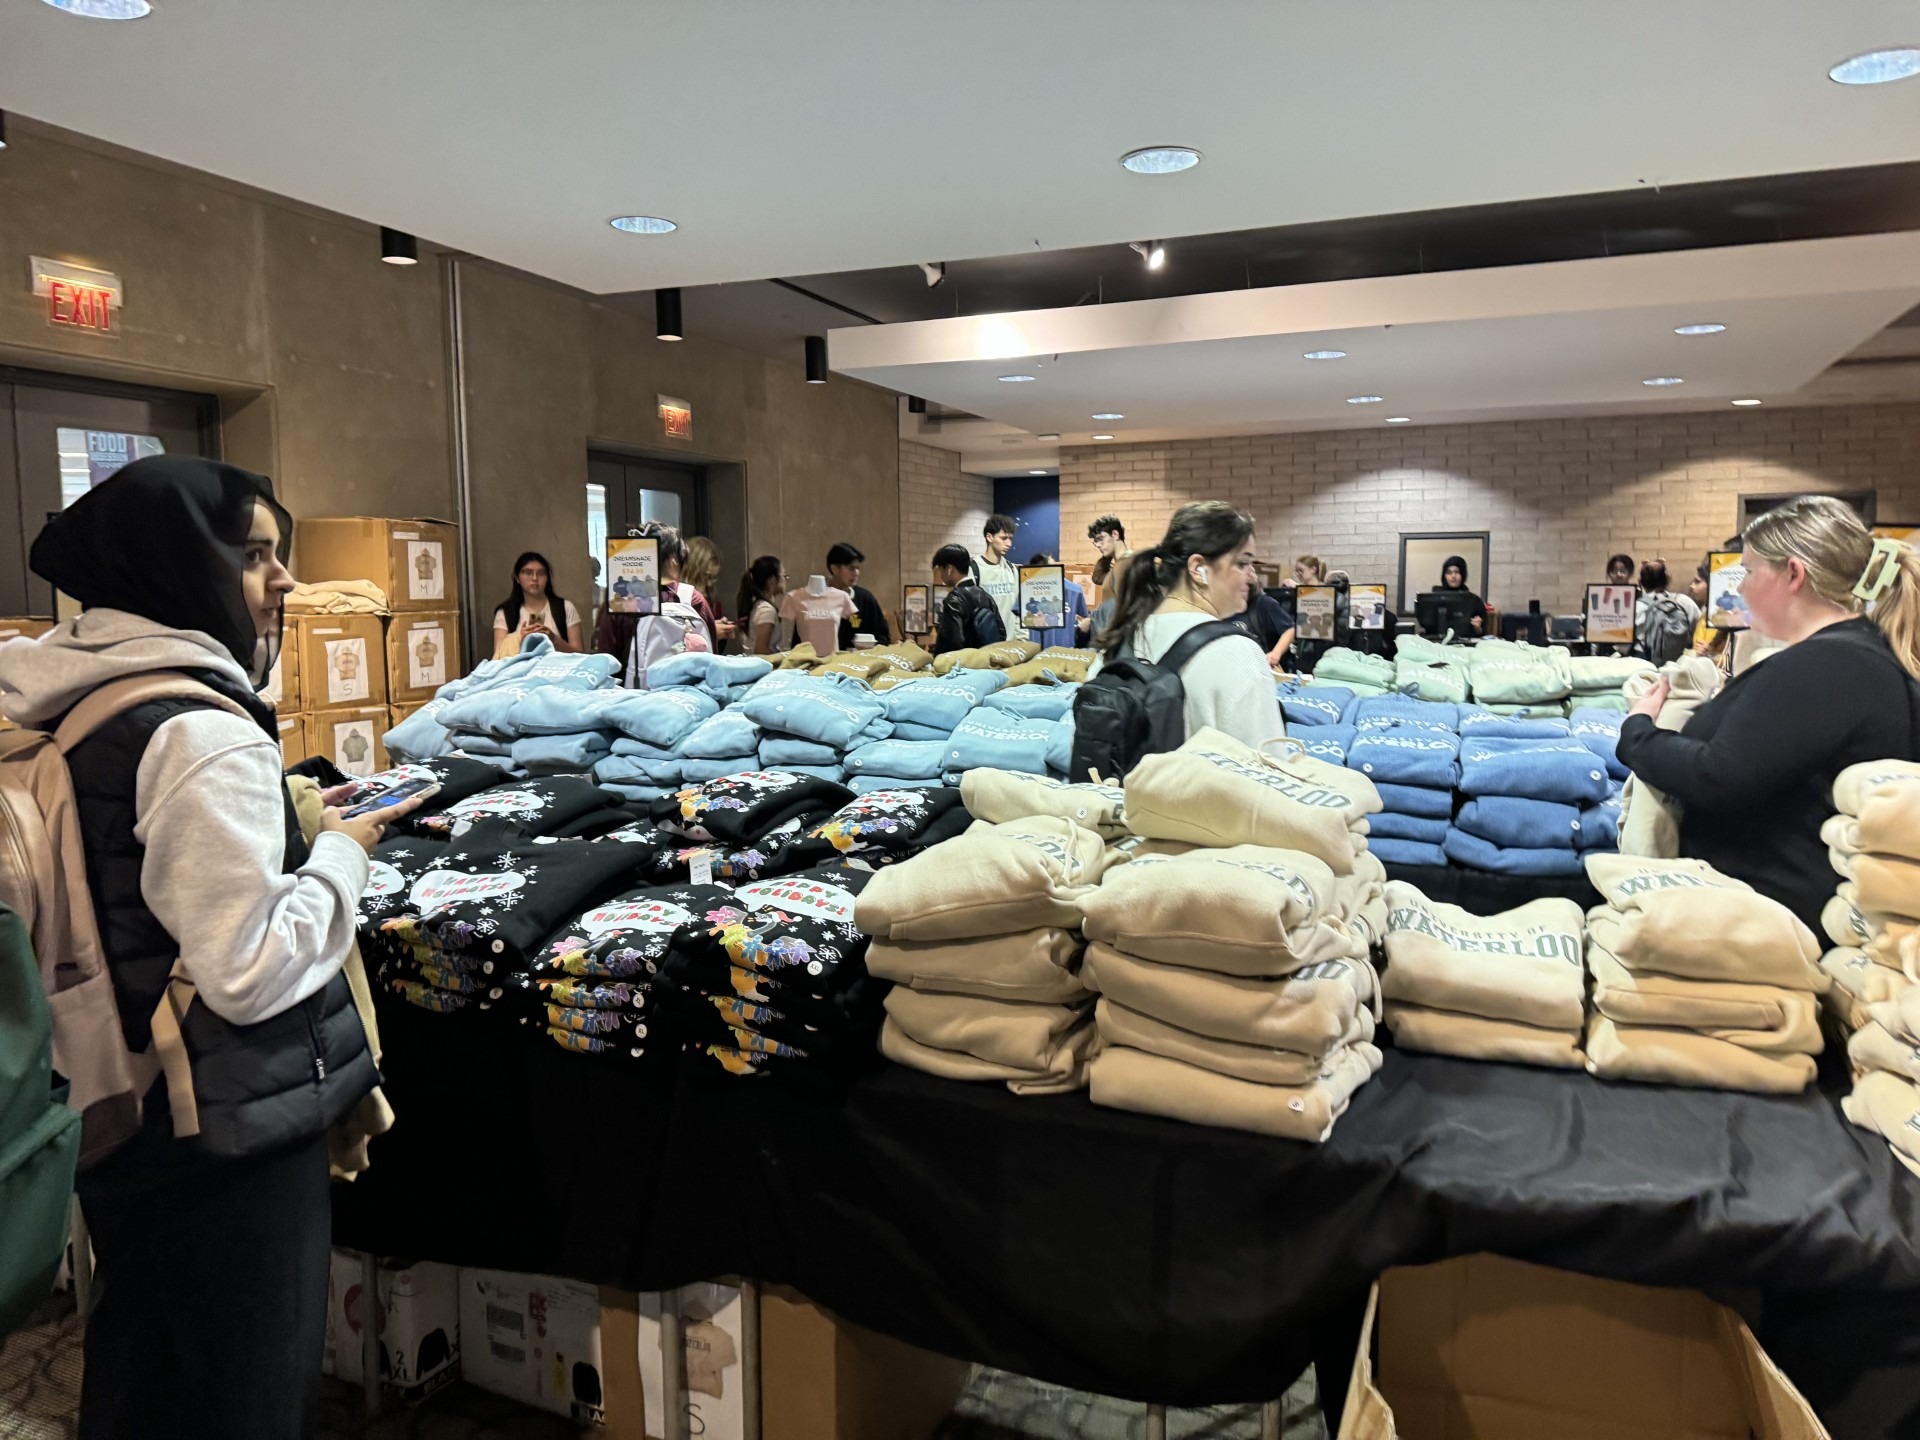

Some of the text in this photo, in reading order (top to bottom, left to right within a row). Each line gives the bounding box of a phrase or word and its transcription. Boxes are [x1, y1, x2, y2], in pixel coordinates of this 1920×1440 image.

[52, 281, 111, 331] EXIT
[89, 432, 127, 453] FOOD
[420, 584, 429, 596] M
[421, 672, 431, 683] M
[343, 683, 353, 696] S
[442, 876, 503, 886] HAPPY
[421, 882, 508, 898] HOLIDAYS!
[768, 881, 839, 898] HAPPY
[747, 887, 848, 916] HOLIDAYS!
[614, 903, 677, 917] HAPPY
[1409, 899, 1546, 938] UNIVERSITY OF
[1388, 908, 1580, 967] WATERLOO
[810, 963, 821, 973] XXL
[396, 1350, 404, 1365] 2
[683, 1403, 705, 1435] S
